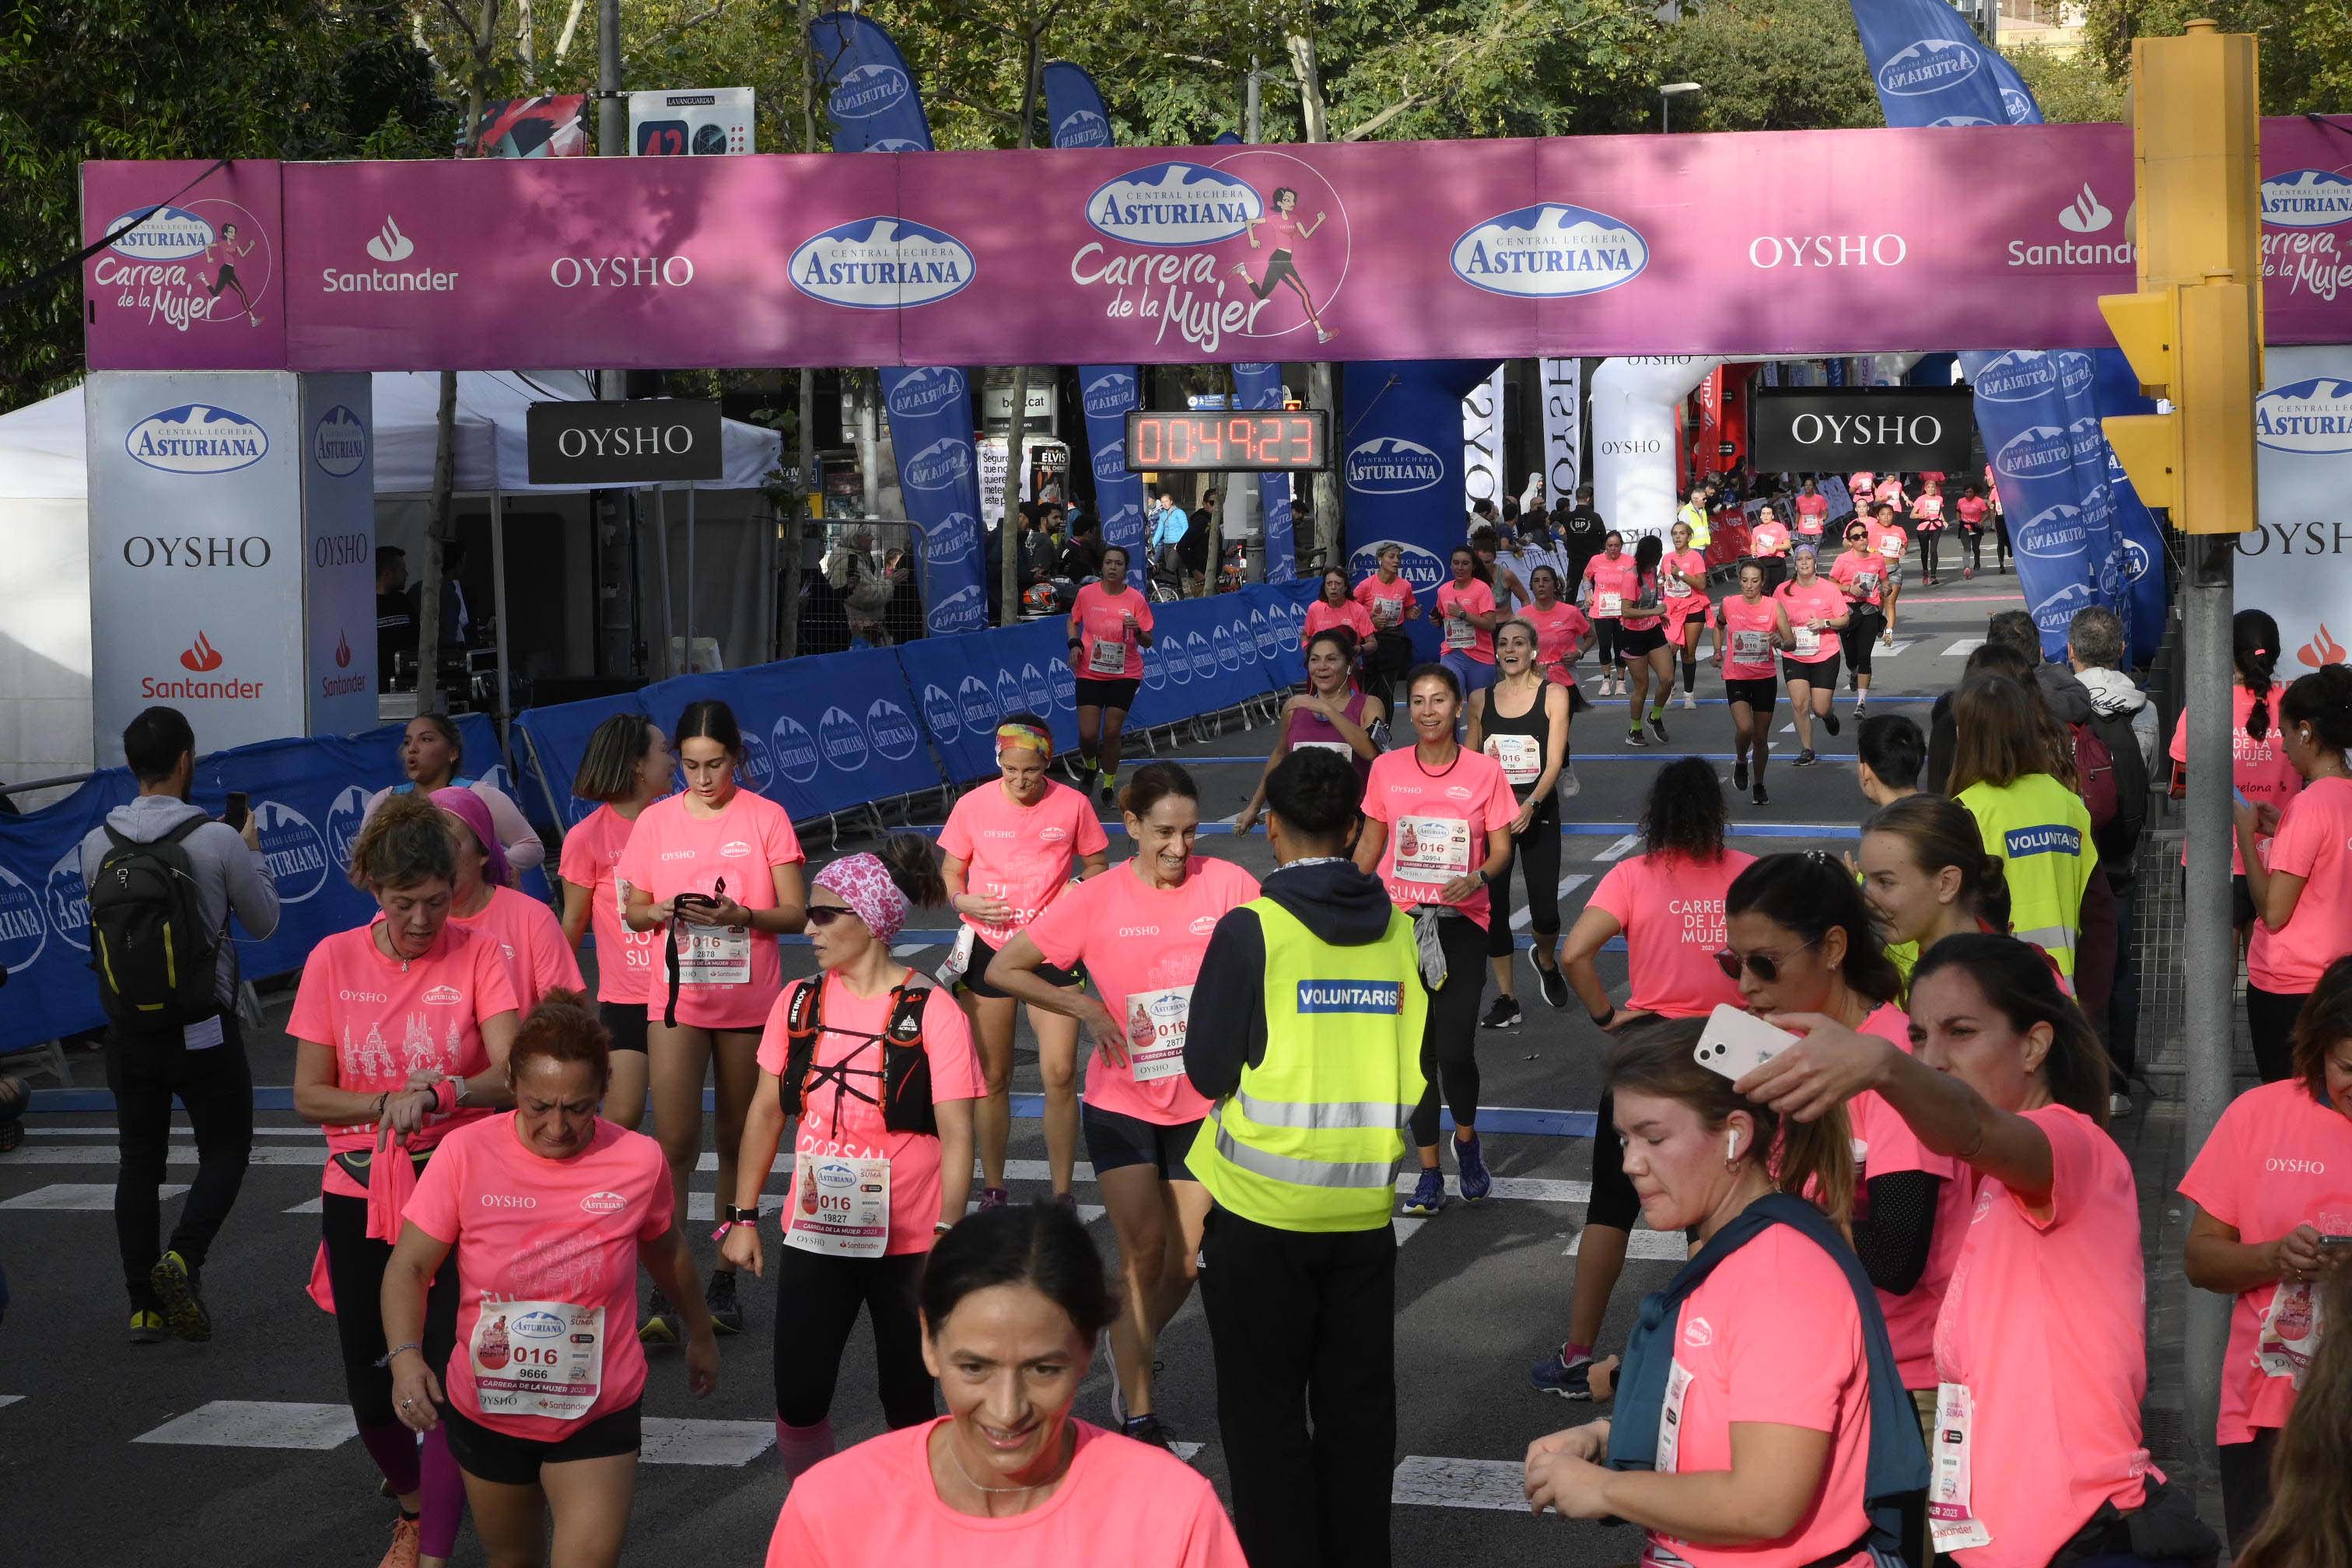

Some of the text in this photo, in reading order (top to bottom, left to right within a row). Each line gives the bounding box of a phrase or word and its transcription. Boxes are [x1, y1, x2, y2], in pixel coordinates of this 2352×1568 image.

[1126, 190, 1244, 200] CENTRAL LECHERA
[2271, 187, 2352, 196] CENTRAL LECHER
[1098, 194, 1248, 226] ASTURIANA
[113, 229, 206, 247] ASTURIANA
[1496, 234, 1627, 247] CENTRAL LECHERA
[2261, 232, 2334, 254] arrera
[831, 247, 955, 257] CENTRAL LECHERA
[1466, 240, 1633, 274] ASTURIANA
[1749, 233, 1907, 268] OYSHO
[2008, 239, 2137, 266] Santand
[803, 250, 961, 285] ASTURIANA
[1071, 241, 1217, 286] Carrera
[95, 257, 187, 286] Carrera
[551, 256, 695, 288] OYSHO
[2280, 255, 2293, 277] la
[2290, 250, 2352, 301] Muje
[323, 267, 459, 292] Santander
[117, 283, 222, 331] de la Mujer
[1106, 281, 1272, 353] de la Mujer
[2256, 406, 2352, 436] ASTURI
[207, 428, 254, 436] LECHERA
[1791, 414, 1942, 446] OYSHO
[138, 430, 259, 457] ASTURIANA
[317, 433, 363, 460] ASTURIANA
[558, 425, 694, 457] OYSHO
[1138, 419, 1313, 462] 00:49:23
[1601, 439, 1661, 455] OYSHO
[1041, 452, 1066, 463] ELVIS
[984, 465, 996, 474] que
[1349, 460, 1437, 481] ASTURIANA
[985, 495, 999, 506] este
[2233, 522, 2352, 556] OYSH
[123, 536, 271, 568] OYSHO
[315, 534, 368, 568] OYSHO
[141, 677, 264, 698] Santander
[322, 672, 366, 698] Santander
[825, 734, 866, 758] ASTURIANA
[2233, 739, 2249, 749] DE
[1502, 754, 1521, 762] 016
[2233, 751, 2272, 761] MUJER
[2235, 782, 2272, 793] celona
[260, 834, 282, 849] ENTRAL
[983, 830, 1016, 839] OYSHO
[2008, 832, 2079, 851] VOLUNTAIS
[661, 850, 695, 861] OYSHO
[1420, 843, 1444, 853] 016
[264, 843, 325, 878] TURIANA
[1389, 884, 1440, 902] SUMA
[1669, 900, 1725, 915] CARRE
[1685, 914, 1727, 928] DE LA
[1119, 926, 1159, 937] OYSHO
[1681, 929, 1727, 943] MUJE
[691, 936, 721, 947] 016
[627, 950, 650, 966] SU
[340, 990, 387, 1003] OYSHO
[424, 992, 459, 1003] ASTURIANA
[1300, 989, 1398, 1006] VOLUNTARIS
[1153, 1002, 1187, 1013] ASTURIANA
[1158, 1020, 1186, 1037] 016
[1166, 1037, 1184, 1048] 2877
[1140, 1051, 1167, 1060] CARRERA
[1139, 1063, 1169, 1074] OYSHO
[2266, 1157, 2325, 1174] OYSHO
[819, 1171, 853, 1185] ASTURIANA
[481, 1195, 536, 1209] OYSHO
[820, 1195, 851, 1210] 016
[823, 1214, 847, 1223] 19827
[796, 1235, 825, 1247] OYSHO
[847, 1241, 880, 1250] Santander
[515, 1321, 562, 1332] ASTURIANA
[513, 1346, 558, 1365] 016
[520, 1368, 548, 1380] 9666
[482, 1380, 518, 1388] CARRERA
[542, 1384, 568, 1392] MUJER
[549, 1402, 587, 1411] Santander
[1942, 1507, 1958, 1517] 2023
